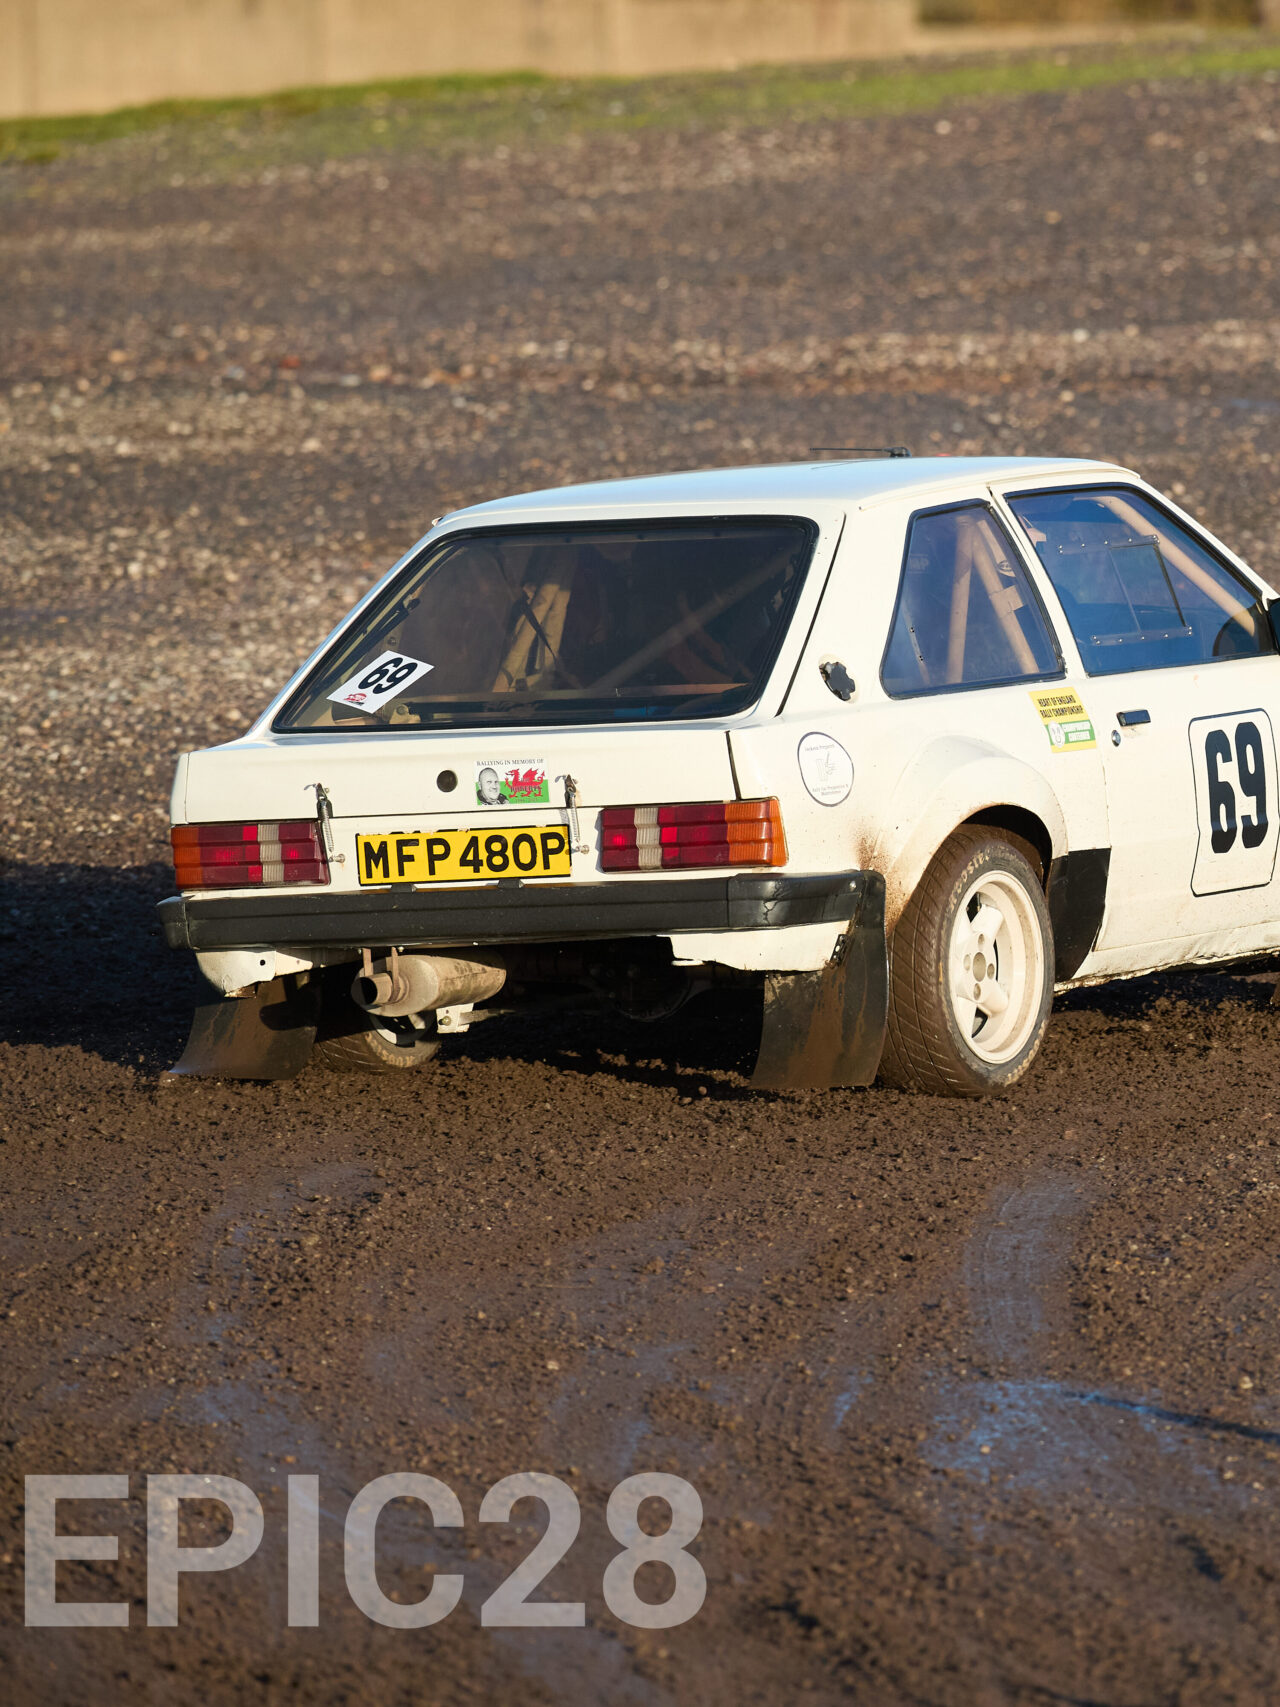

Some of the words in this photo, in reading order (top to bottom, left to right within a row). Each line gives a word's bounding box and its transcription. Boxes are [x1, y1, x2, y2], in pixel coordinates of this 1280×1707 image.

[358, 657, 418, 694] 69
[1037, 698, 1052, 707] HEART
[1056, 695, 1076, 705] ENGLAND
[1040, 708, 1053, 718] RALLY
[1052, 705, 1084, 717] CHAMPIONSHIP
[1205, 721, 1269, 854] 69
